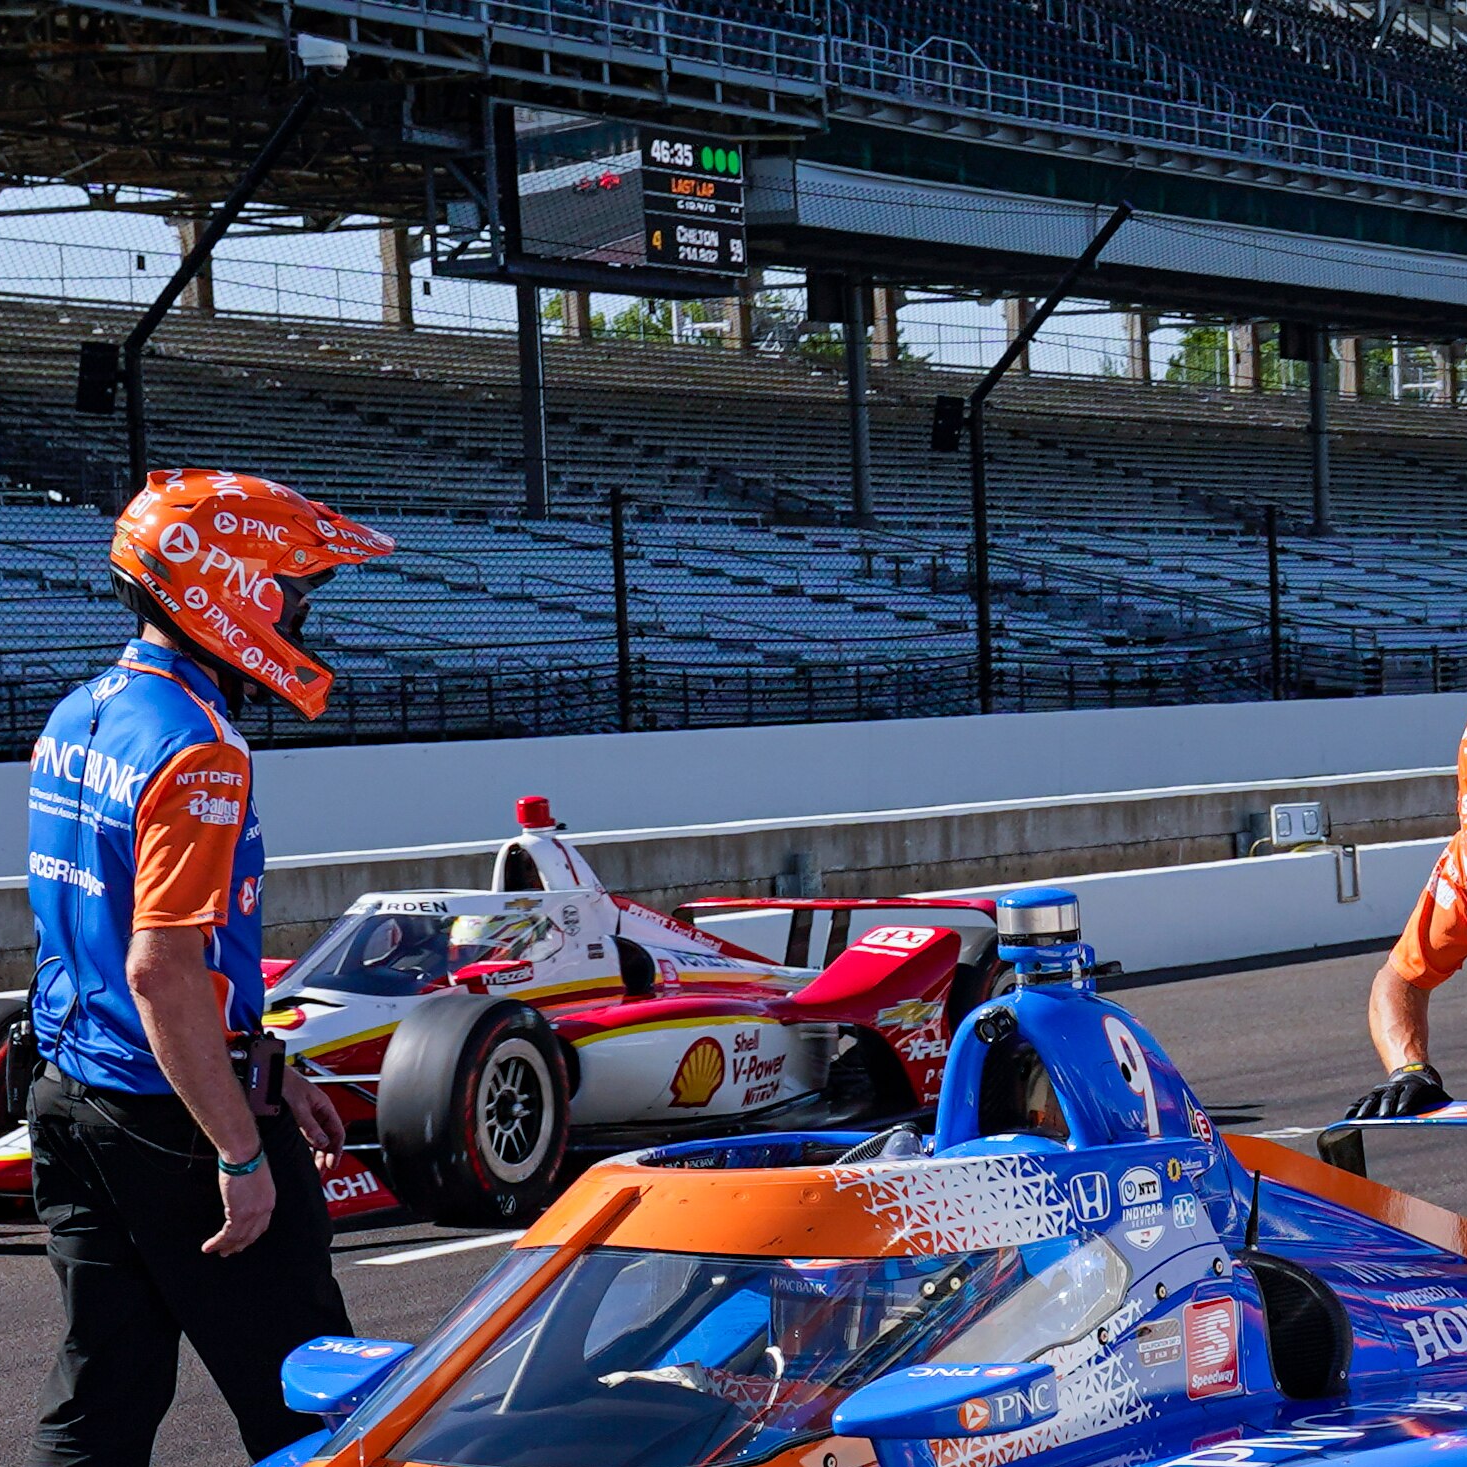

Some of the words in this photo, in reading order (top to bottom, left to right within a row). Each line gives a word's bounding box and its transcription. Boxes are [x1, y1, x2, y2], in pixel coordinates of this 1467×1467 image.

[651, 139, 694, 167] 46:35
[671, 177, 695, 194] LAST
[696, 182, 715, 197] LAP
[652, 230, 662, 250] 4
[676, 225, 719, 247] CHILTON
[242, 517, 289, 545] PNC
[340, 527, 376, 549] PNC
[199, 543, 281, 612] PNC
[140, 572, 182, 613] BLAIR
[203, 604, 247, 646] PNC
[261, 660, 299, 694] PNC
[176, 771, 208, 786] NTT
[202, 814, 239, 825] SPOR
[734, 1028, 760, 1053] Shell
[903, 1037, 949, 1062] XPEL
[732, 1053, 787, 1085] V-Power
[1102, 1014, 1162, 1138] 9
[323, 1170, 379, 1203] ACHI
[1138, 1181, 1157, 1195] NTT
[1122, 1202, 1164, 1222] INDYCAR
[1132, 1217, 1156, 1228] SERIES
[1174, 1198, 1194, 1224] PPG
[1385, 1285, 1444, 1313] POWERED
[309, 1341, 368, 1355] PNC
[908, 1367, 981, 1377] PNC
[1191, 1369, 1235, 1390] Speedway
[995, 1383, 1052, 1424] PNC
